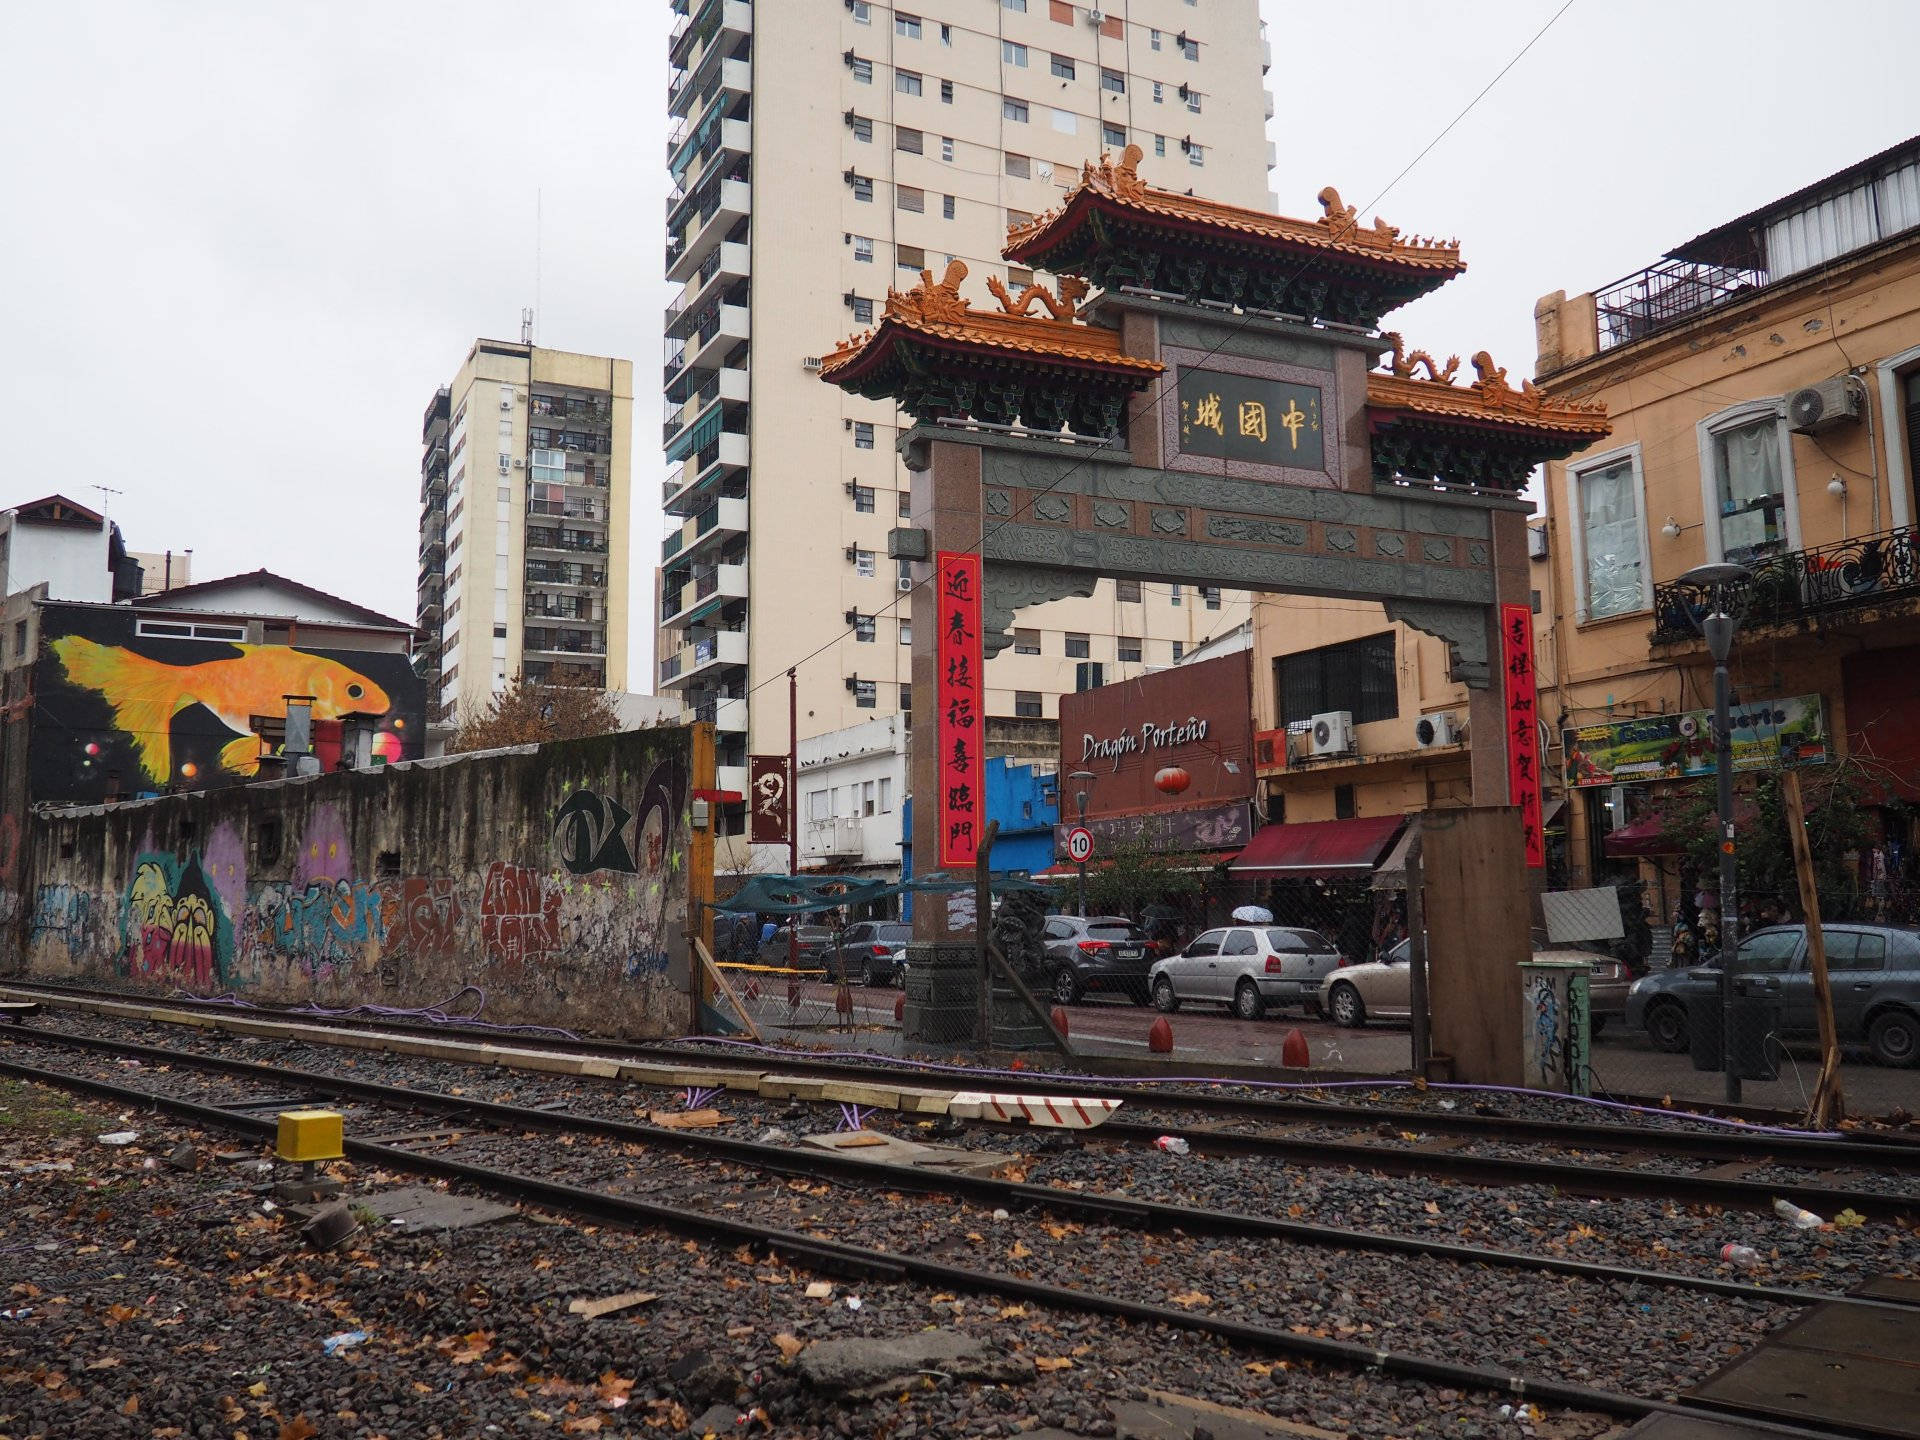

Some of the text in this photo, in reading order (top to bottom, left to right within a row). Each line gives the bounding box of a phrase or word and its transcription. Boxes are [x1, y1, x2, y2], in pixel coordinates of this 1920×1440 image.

[945, 569, 974, 851] 迎春接福喜臨門
[1082, 716, 1208, 773] Dragón Porteño
[1072, 838, 1088, 853] 10
